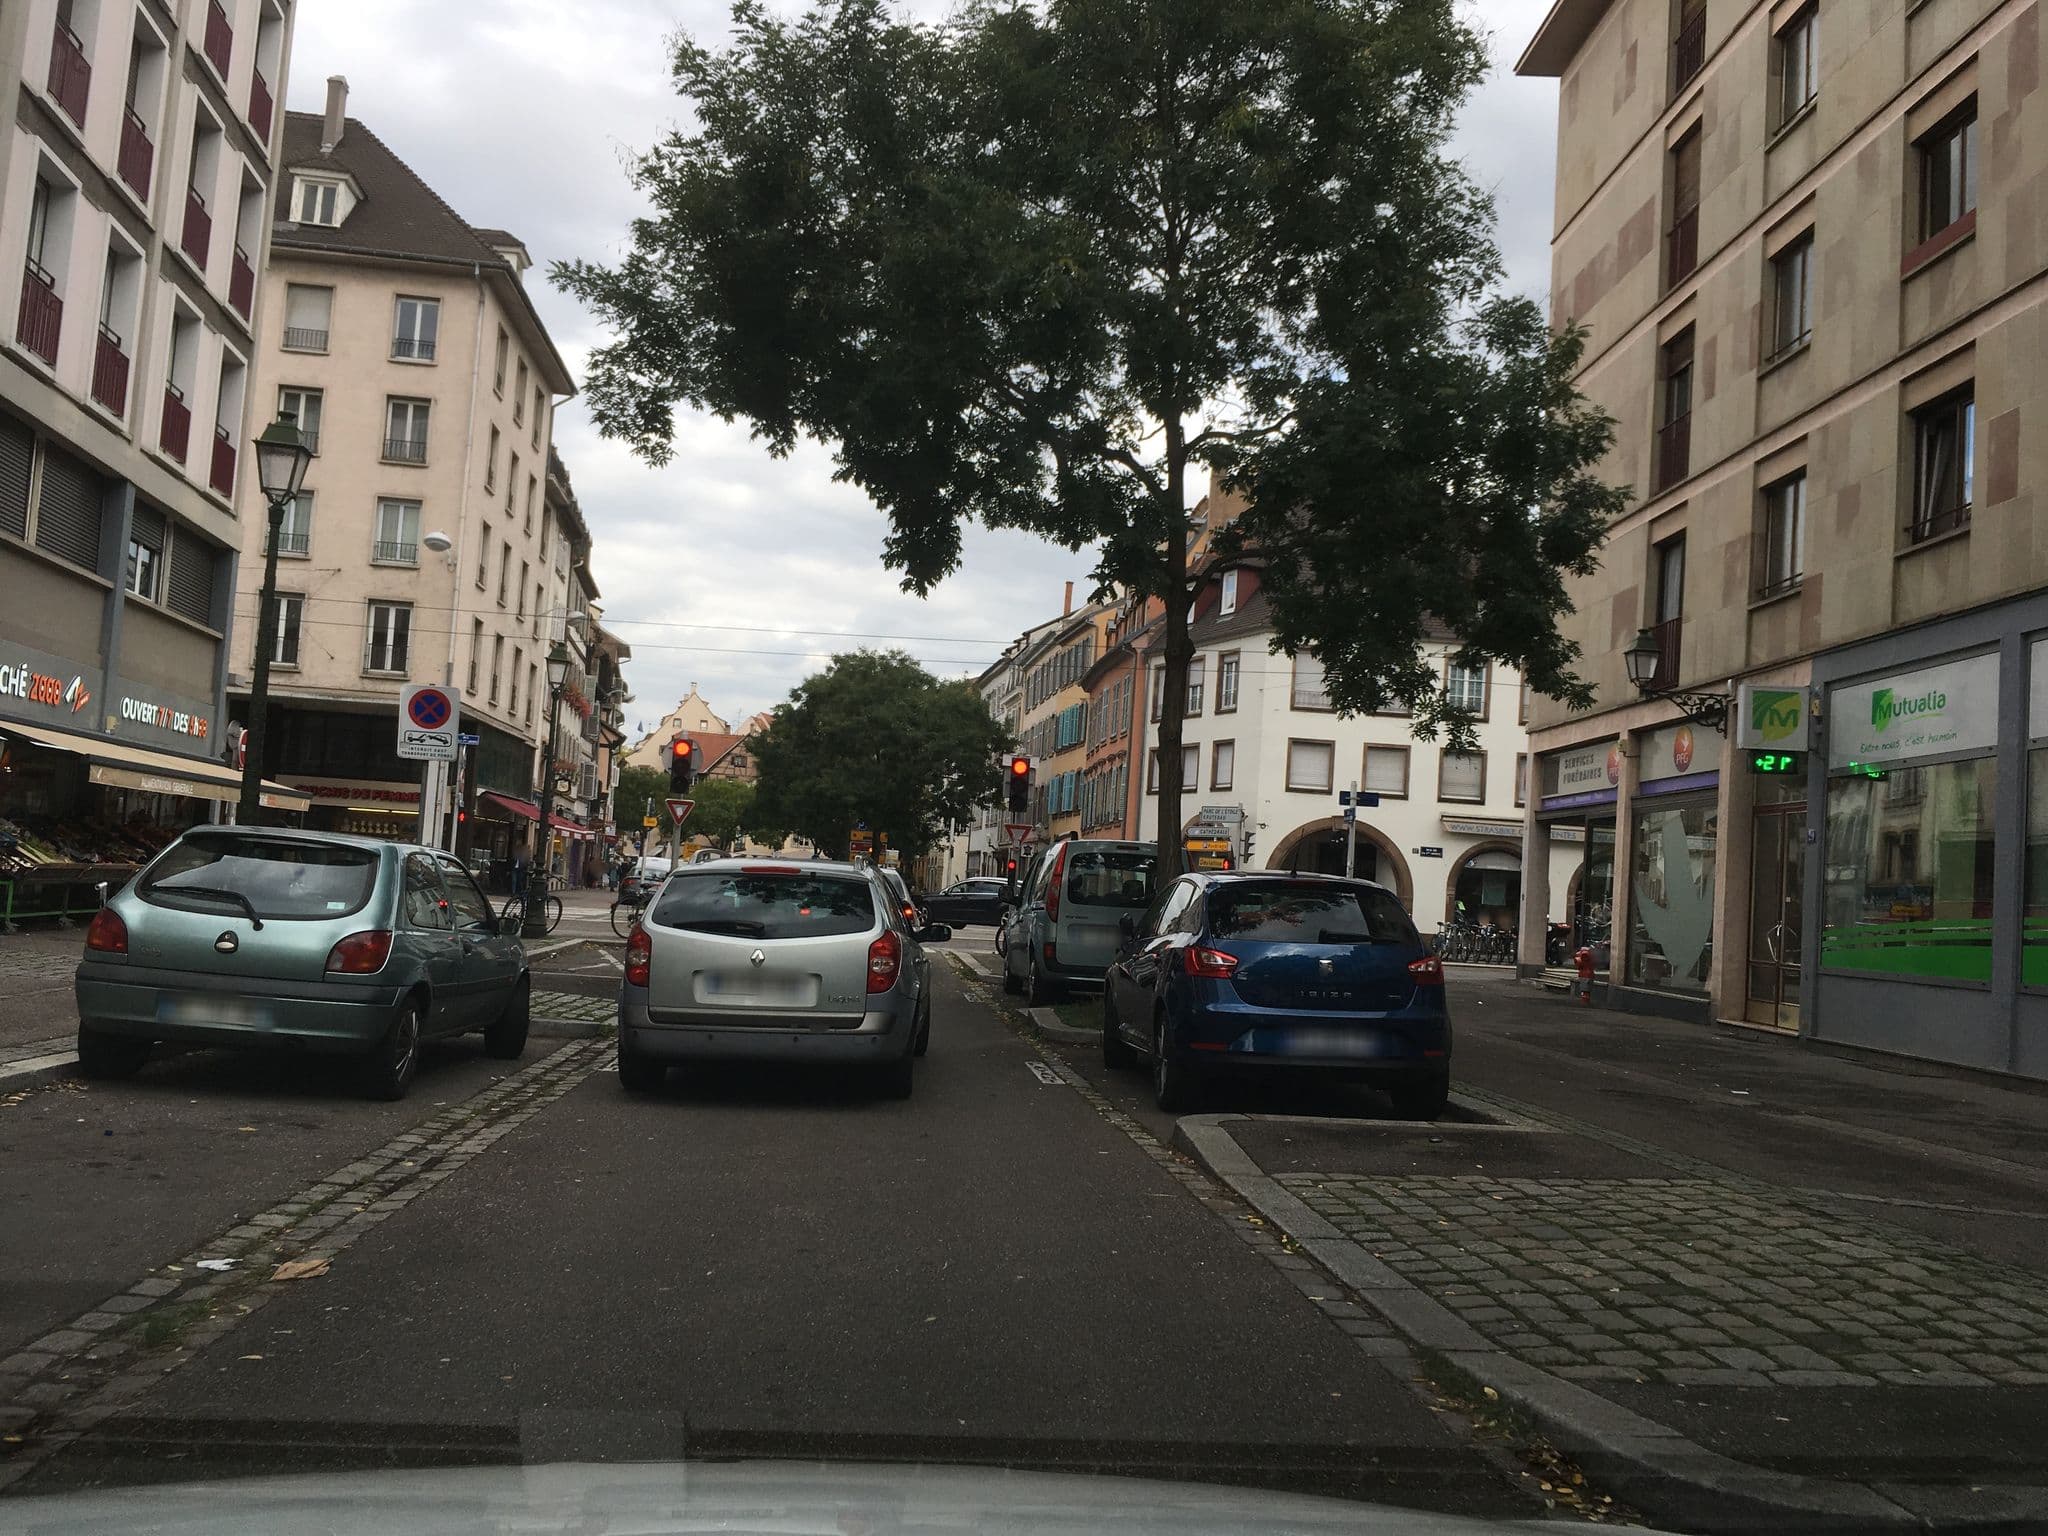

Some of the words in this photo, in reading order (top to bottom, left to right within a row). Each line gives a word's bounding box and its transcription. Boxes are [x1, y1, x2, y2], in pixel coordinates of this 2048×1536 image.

[0, 663, 28, 697] CHÉ
[30, 672, 61, 705] 2000
[122, 697, 158, 724] OUVERT
[156, 706, 174, 728] 7/7
[1877, 690, 1946, 720] Mutualia
[1860, 743, 1879, 753] Entre
[1928, 729, 1958, 743] humain
[1564, 753, 1594, 769] SERVICES
[1676, 753, 1688, 765] PFG
[1563, 767, 1602, 784] FUNÉRAIRES
